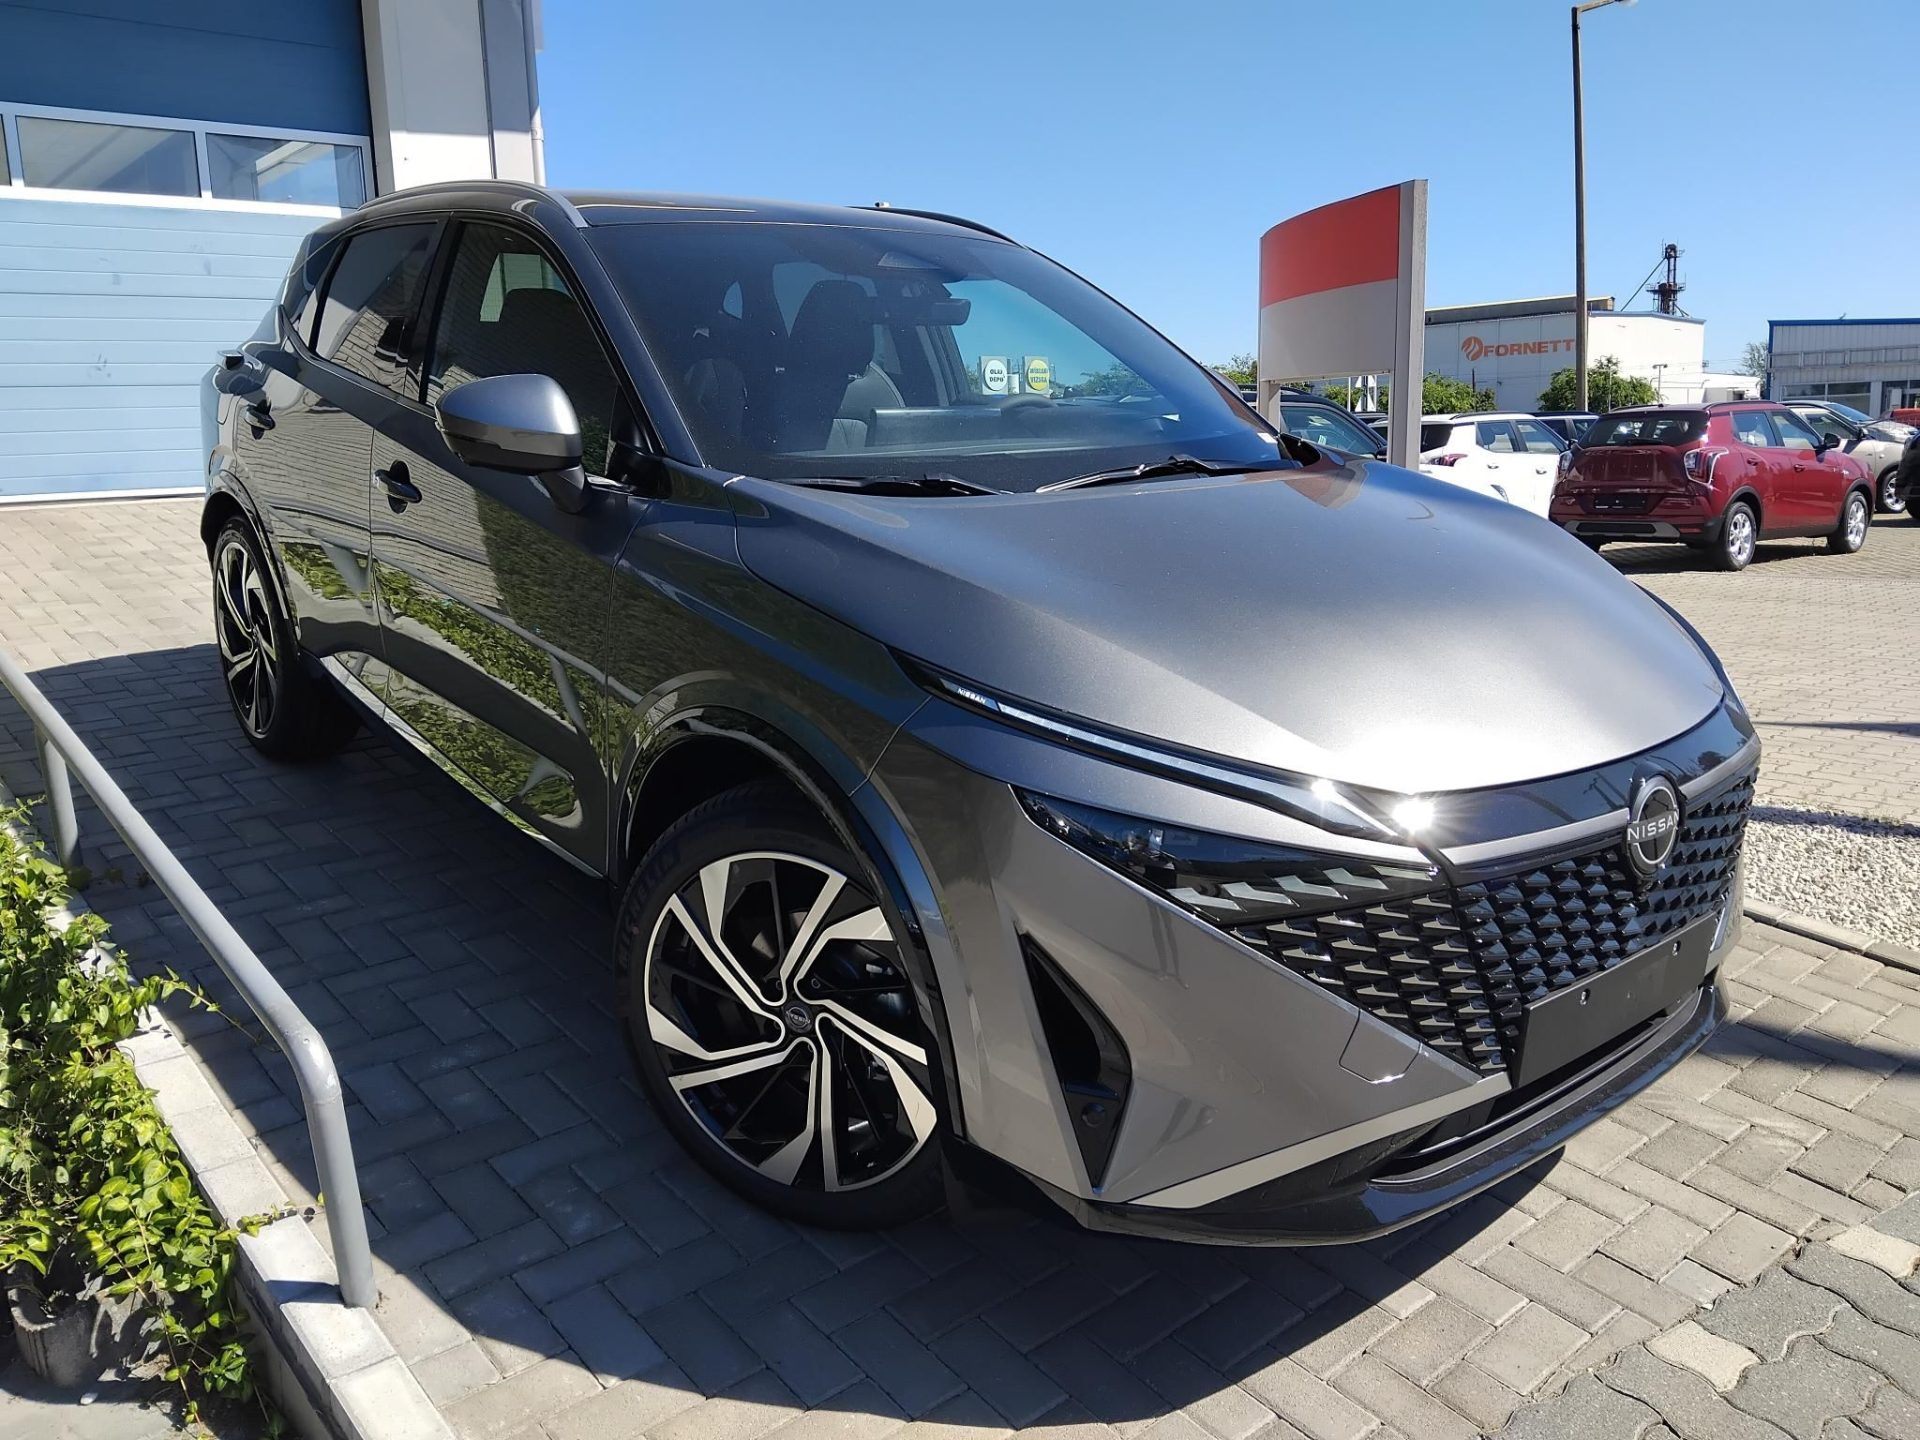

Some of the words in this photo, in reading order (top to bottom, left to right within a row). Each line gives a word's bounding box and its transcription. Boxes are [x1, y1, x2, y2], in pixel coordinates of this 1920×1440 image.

[1483, 339, 1576, 357] FORNETT
[957, 687, 986, 704] NISSAN
[1627, 811, 1679, 841] NISSAN
